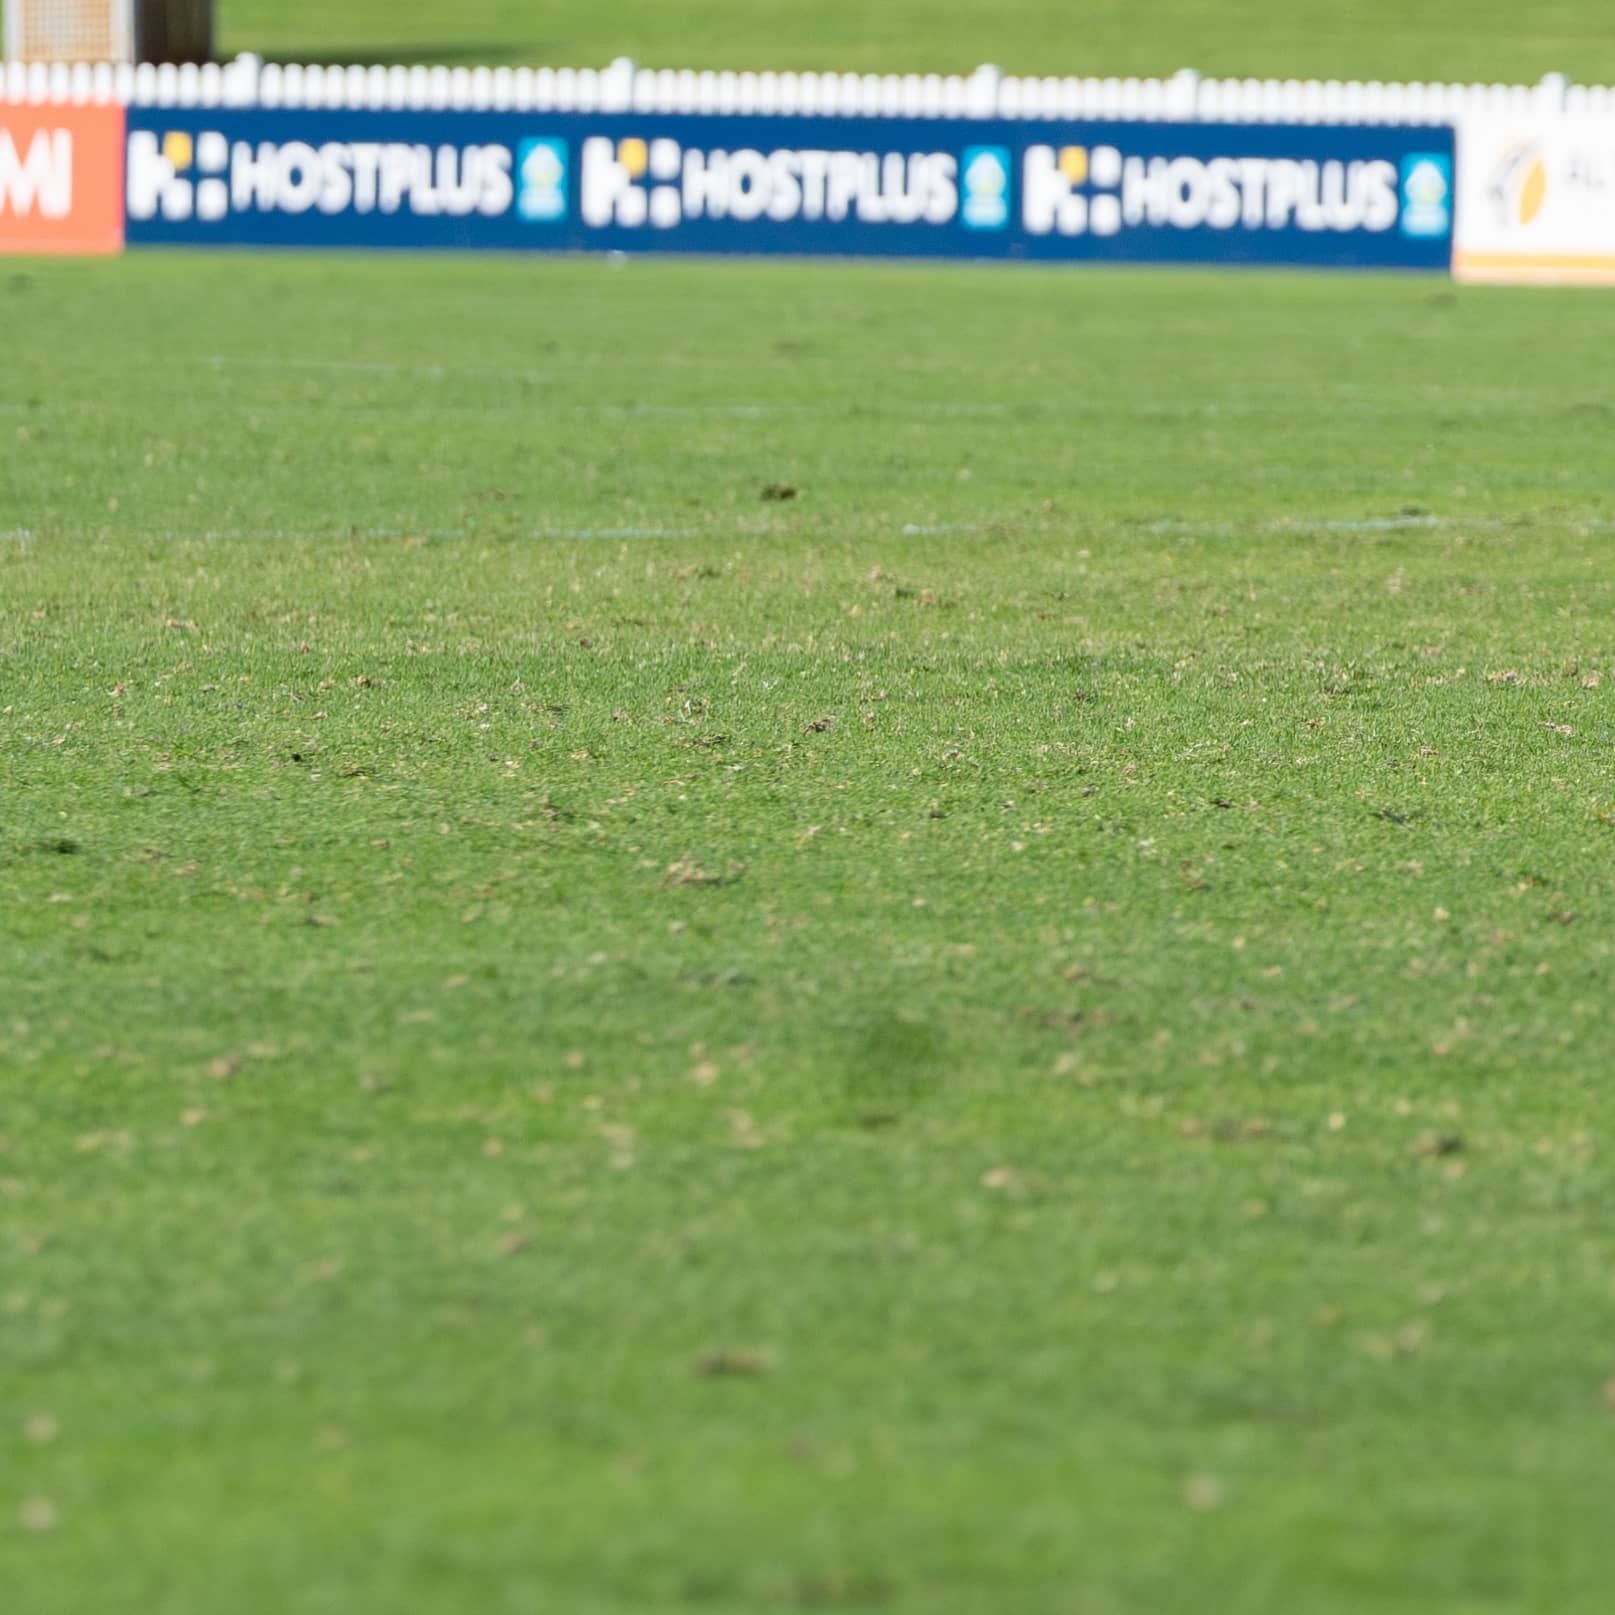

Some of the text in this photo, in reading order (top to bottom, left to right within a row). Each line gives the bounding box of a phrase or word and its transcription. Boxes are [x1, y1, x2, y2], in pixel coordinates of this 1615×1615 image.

[230, 140, 513, 216] HOSTPLUS
[683, 147, 958, 224] HOSTPLUS
[1122, 154, 1399, 232] HOSTPLUS
